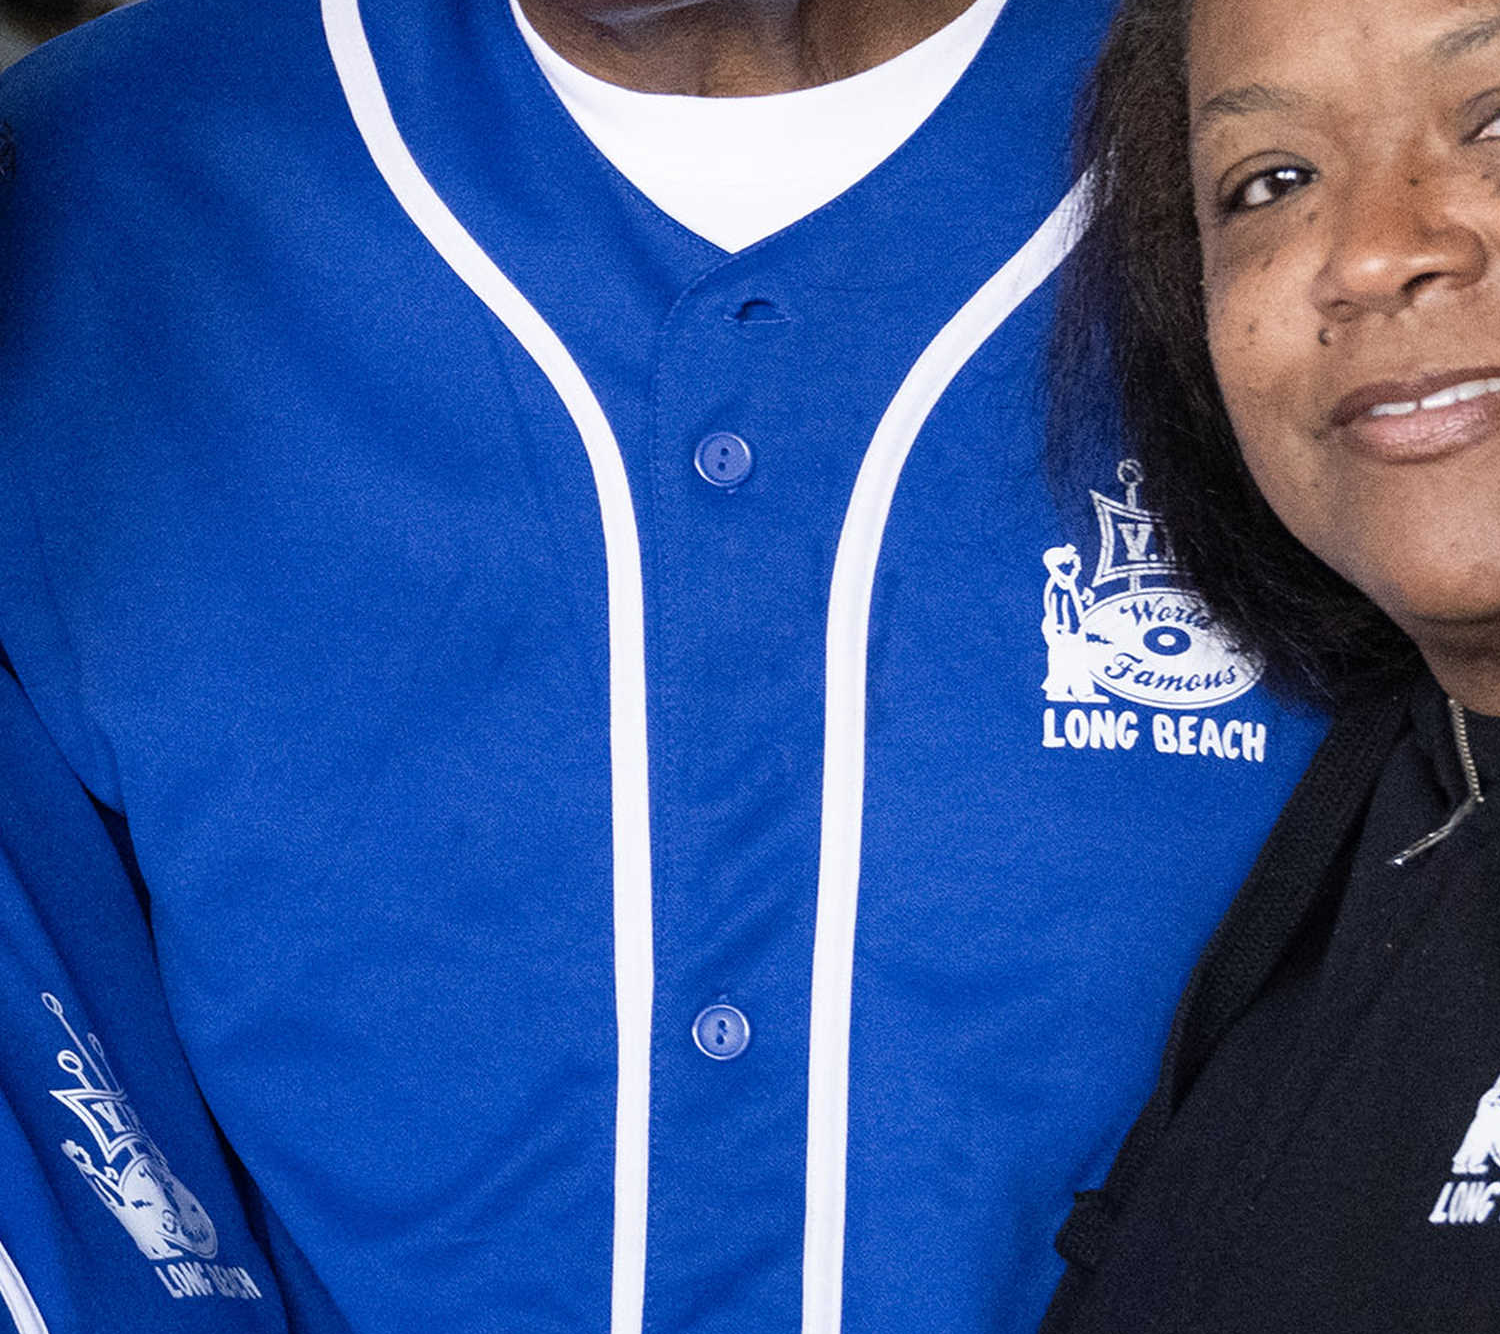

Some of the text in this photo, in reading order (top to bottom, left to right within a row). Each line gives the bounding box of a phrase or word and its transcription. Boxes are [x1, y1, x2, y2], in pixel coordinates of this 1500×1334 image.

[1104, 650, 1238, 692] Famous
[1041, 707, 1268, 764] LONG BEACH
[153, 1260, 214, 1300] LONG
